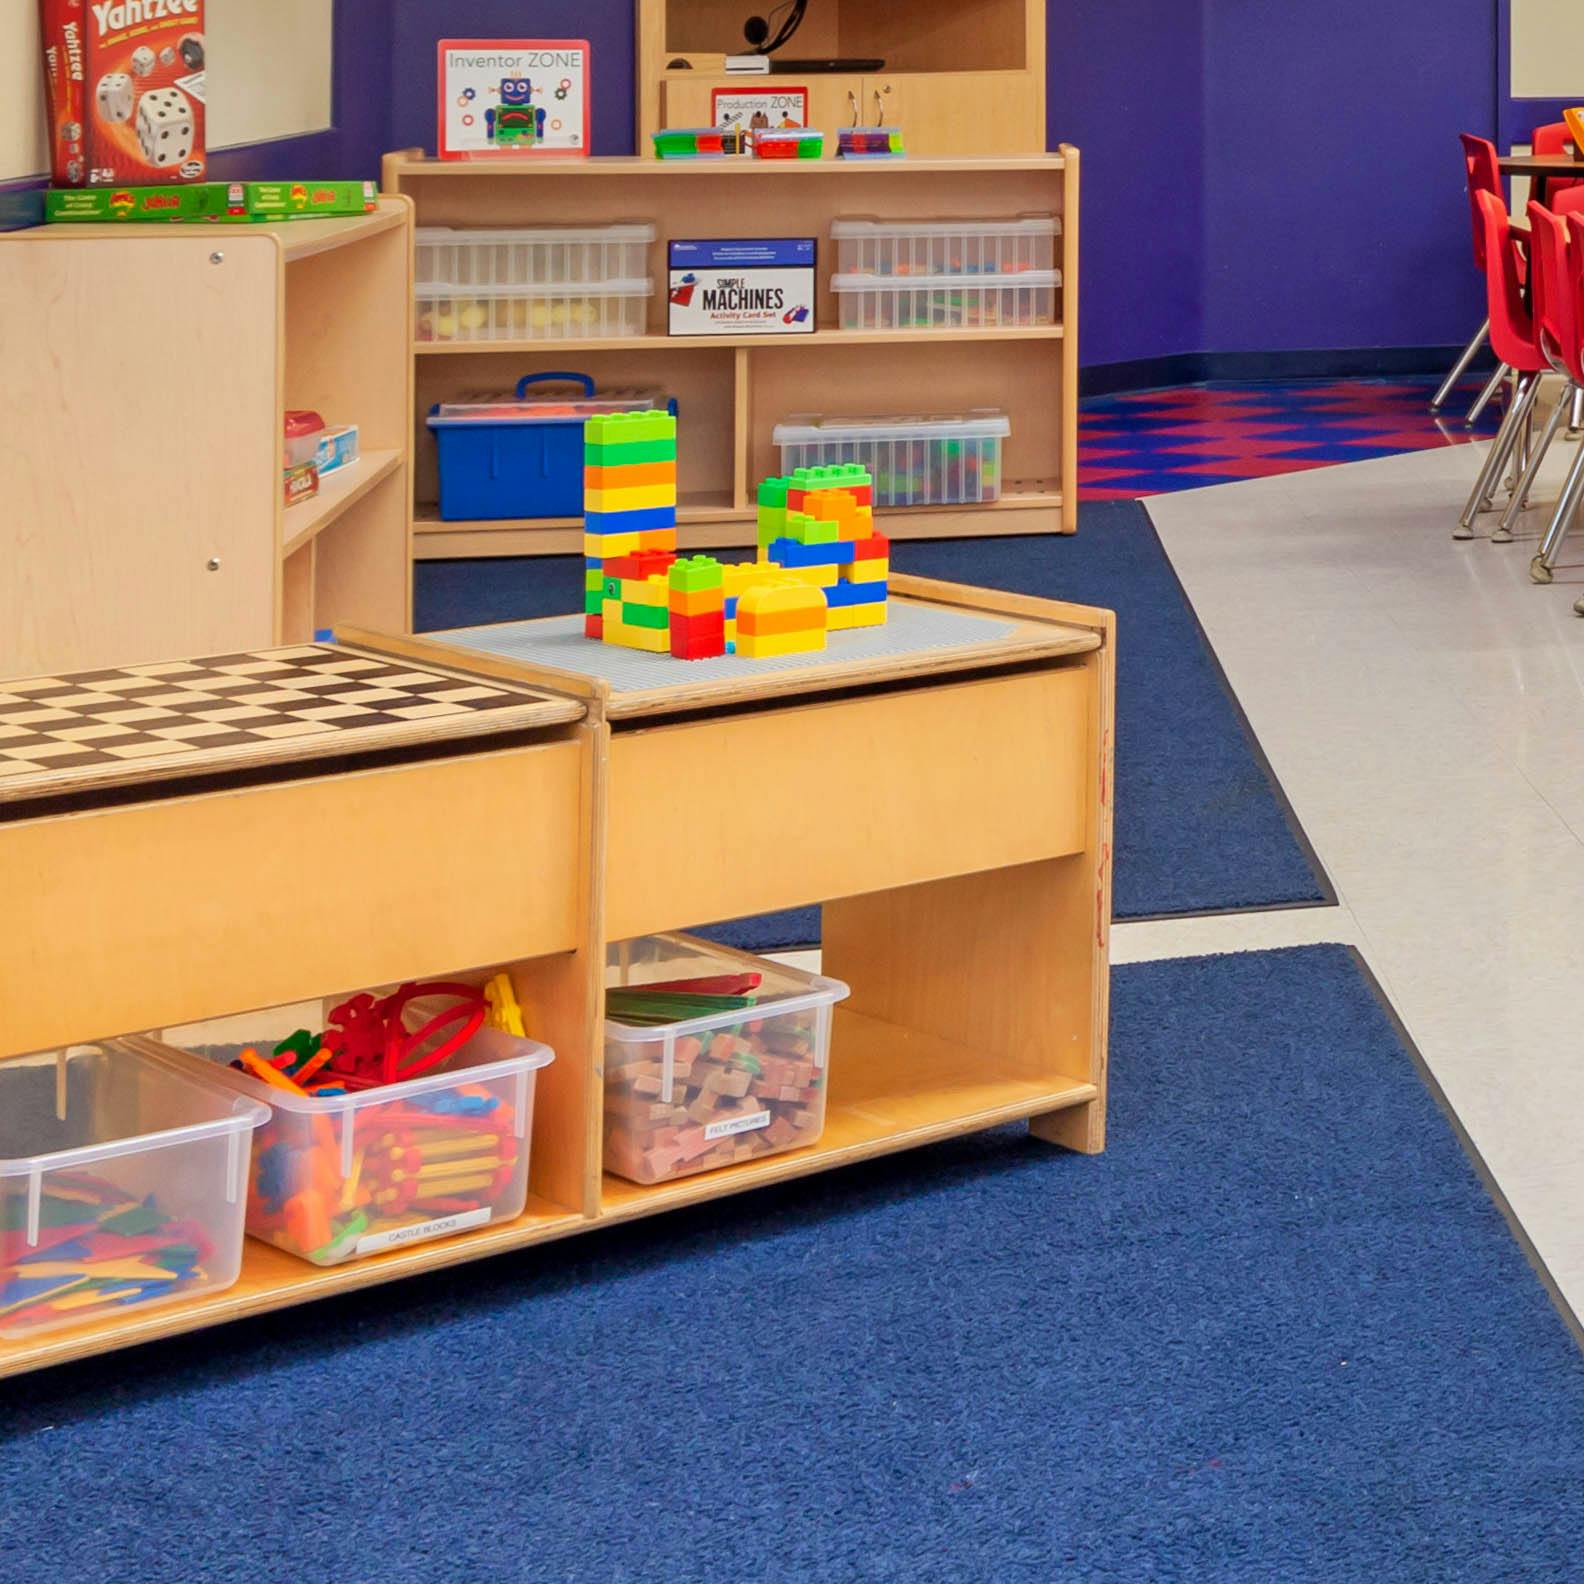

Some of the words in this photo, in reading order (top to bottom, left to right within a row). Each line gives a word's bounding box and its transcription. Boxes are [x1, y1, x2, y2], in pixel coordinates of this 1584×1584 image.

[63, 21, 84, 81] Yahtzee
[449, 52, 523, 68] Inventor
[528, 52, 581, 68] ZONE
[717, 99, 768, 110] Production
[770, 96, 803, 109] ZONE
[716, 278, 745, 289] SIMPLE
[702, 288, 784, 311] MACHINES
[710, 311, 741, 320] Activity
[743, 311, 761, 319] Card
[763, 311, 777, 319] Set
[388, 1227, 420, 1242] CASTLE
[423, 1219, 457, 1234] BLOCKS
